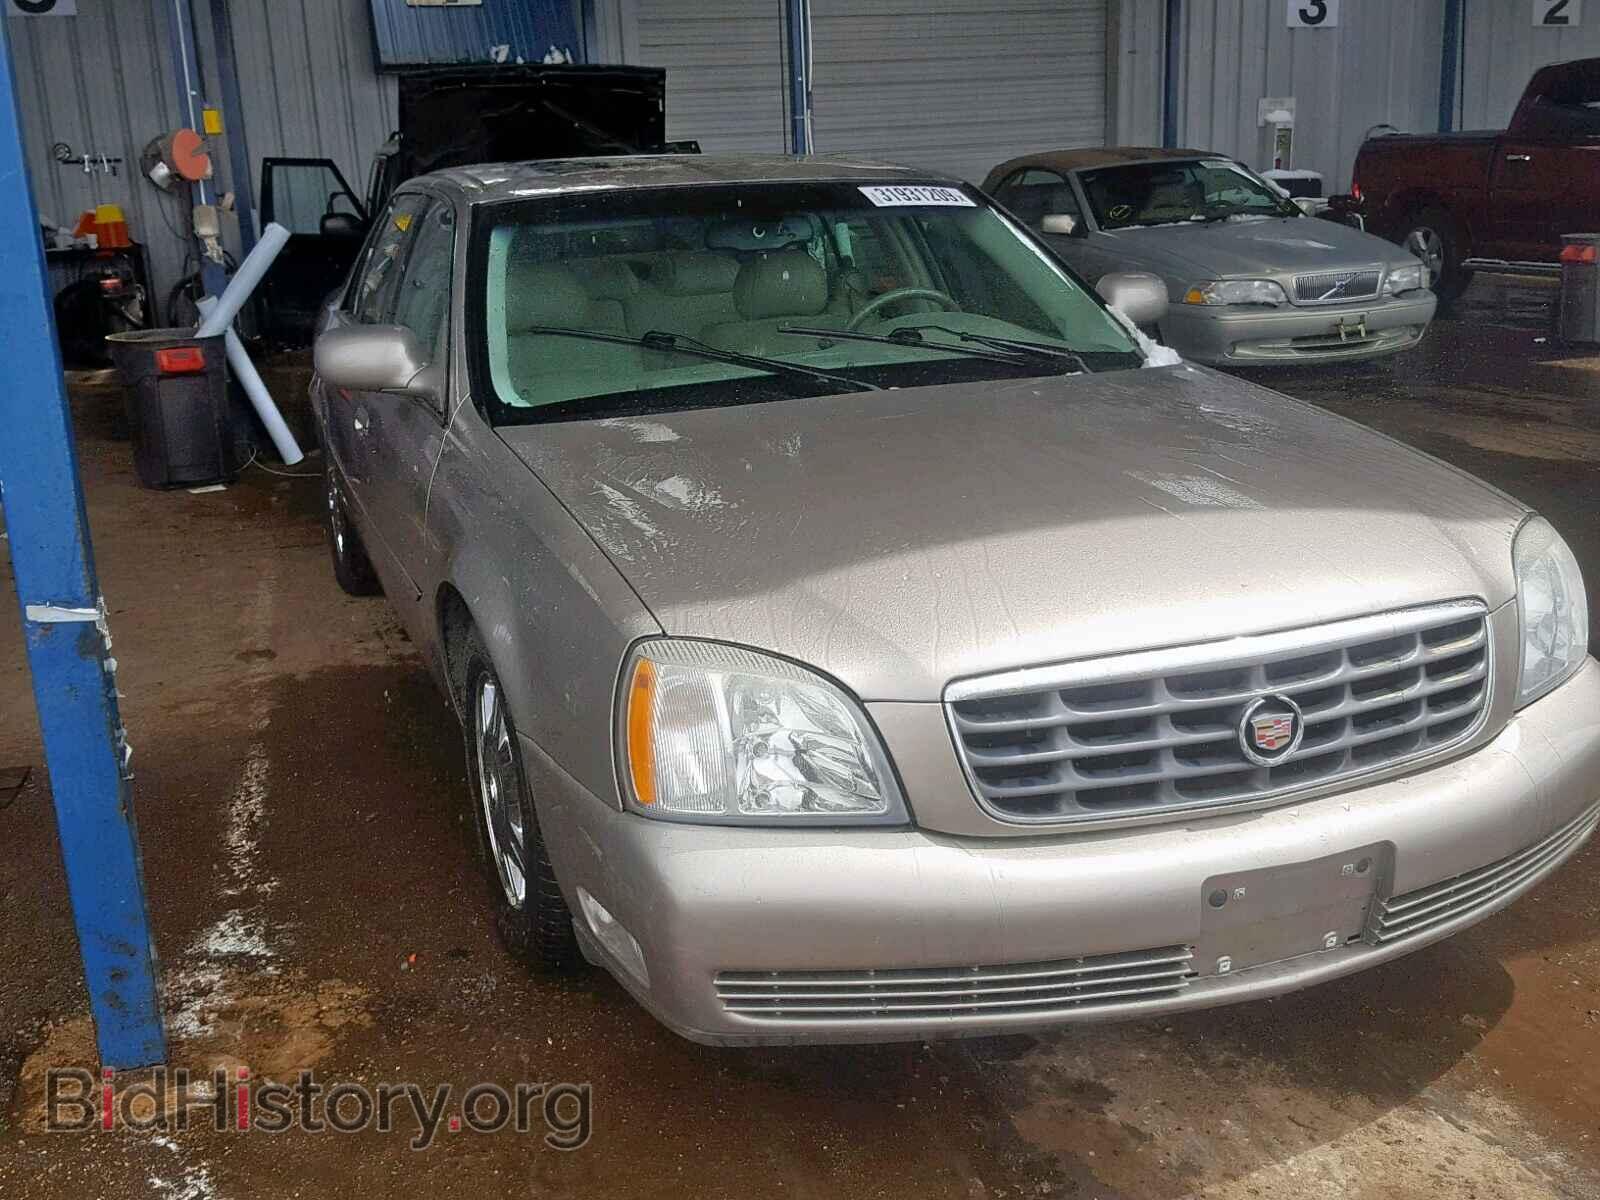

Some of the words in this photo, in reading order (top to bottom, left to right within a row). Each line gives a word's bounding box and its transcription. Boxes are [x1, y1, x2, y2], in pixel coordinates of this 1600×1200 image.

[1299, 0, 1327, 25] 3
[1542, 0, 1569, 25] 2
[873, 187, 958, 202] 31931209
